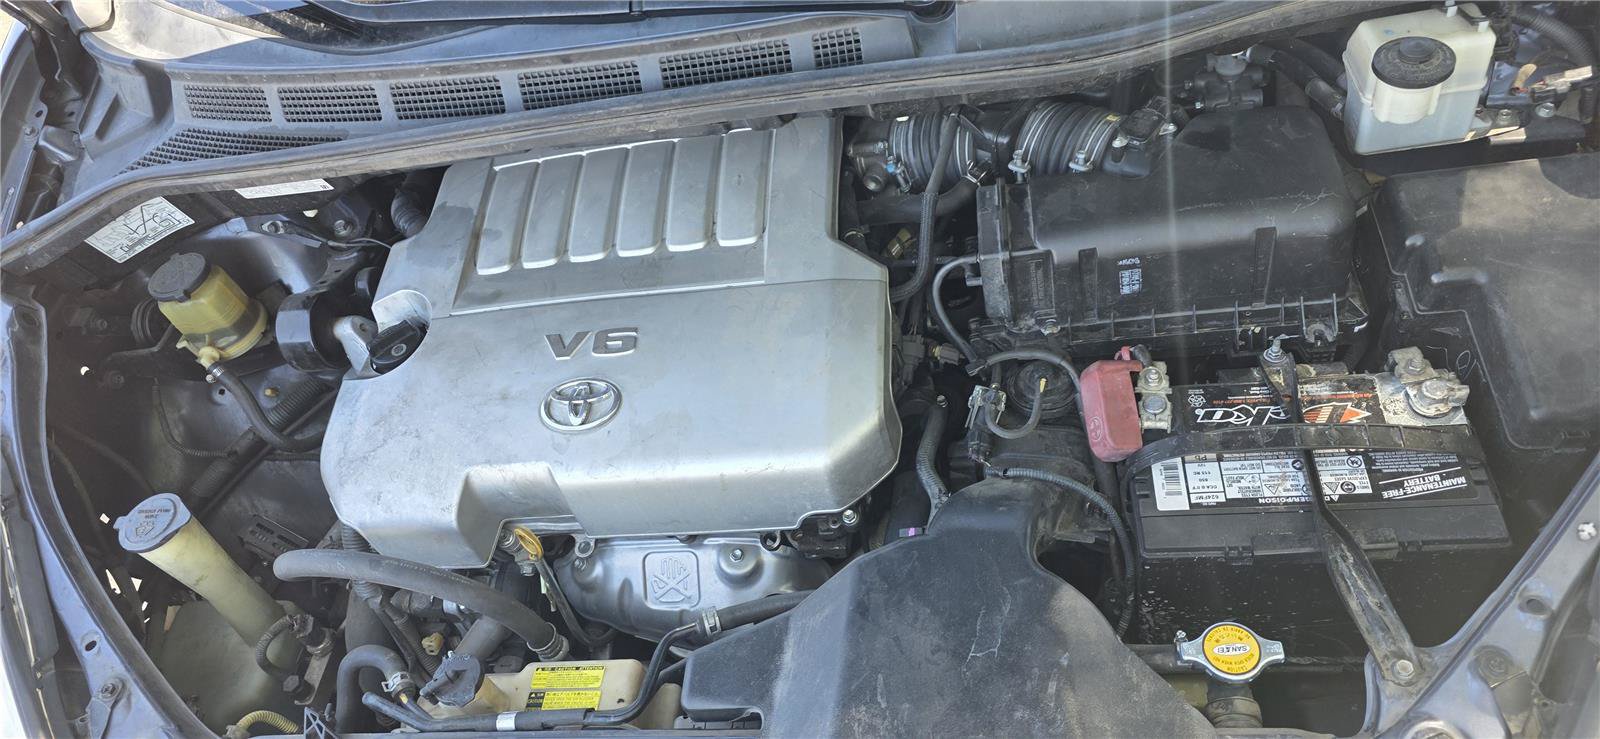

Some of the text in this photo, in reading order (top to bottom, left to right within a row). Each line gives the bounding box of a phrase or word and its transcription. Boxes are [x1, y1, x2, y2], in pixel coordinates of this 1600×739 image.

[544, 327, 639, 360] V6
[1381, 476, 1467, 499] MAINTENANCE-FREE
[1403, 474, 1441, 488] BATTERY
